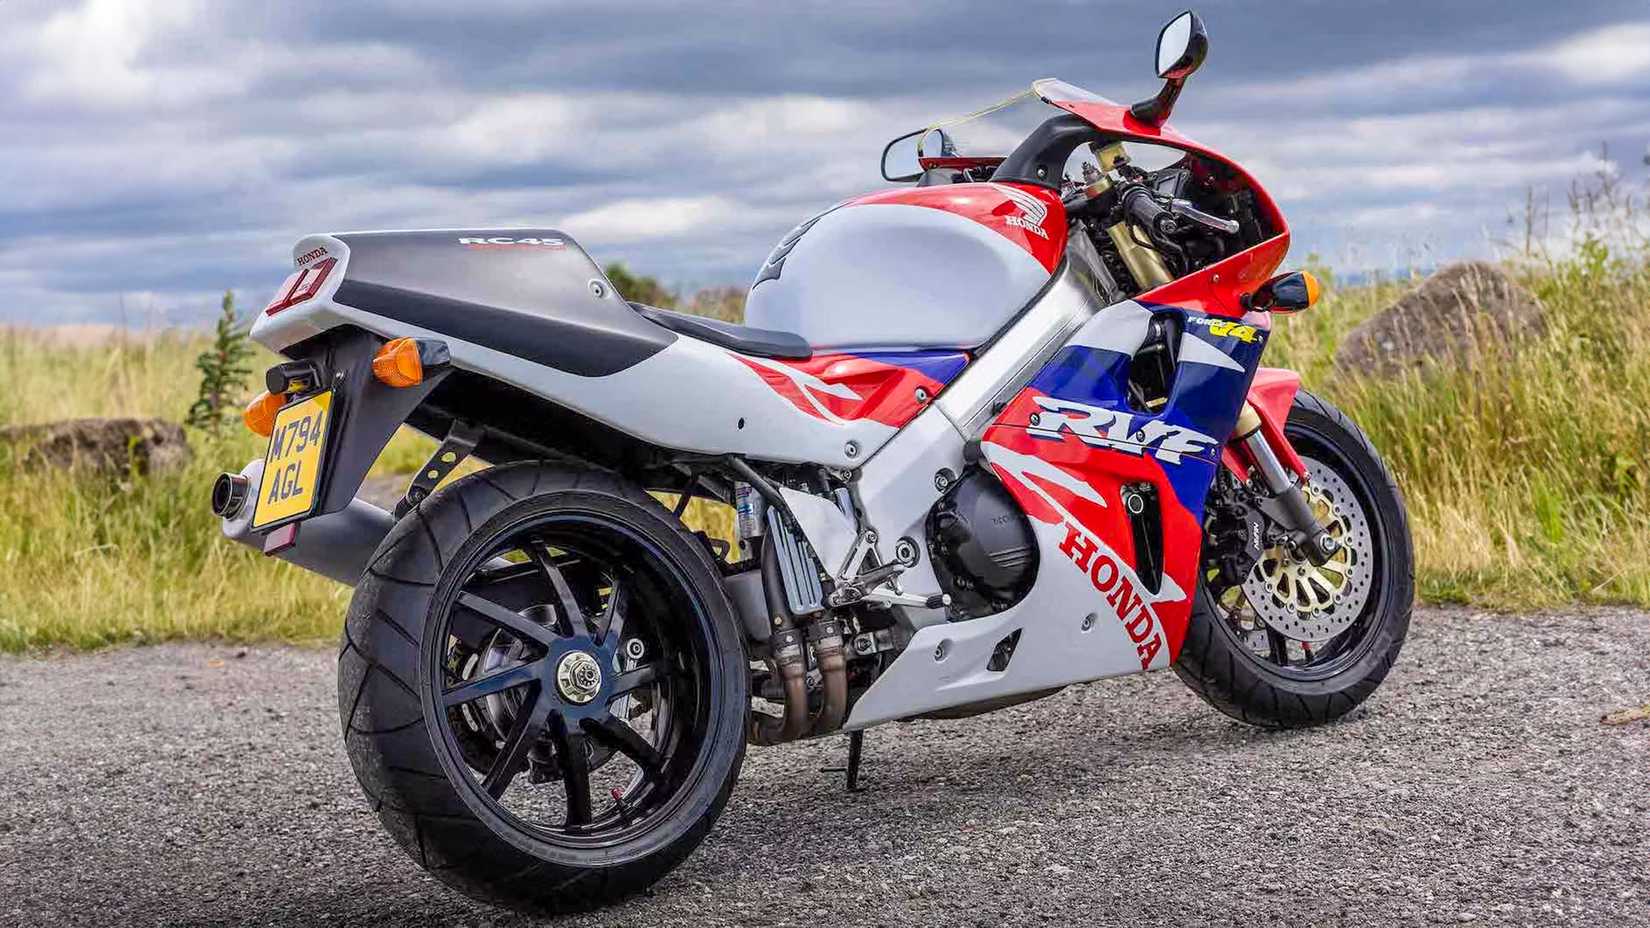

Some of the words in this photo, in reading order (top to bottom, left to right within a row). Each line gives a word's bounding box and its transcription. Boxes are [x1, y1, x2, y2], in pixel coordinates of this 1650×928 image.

[459, 237, 564, 246] RC45
[1004, 215, 1049, 240] HONDA
[297, 246, 328, 265] HONDA
[270, 410, 323, 463] M794
[1026, 396, 1219, 465] RVF
[267, 460, 303, 504] AGL
[1059, 522, 1162, 670] HONDA
